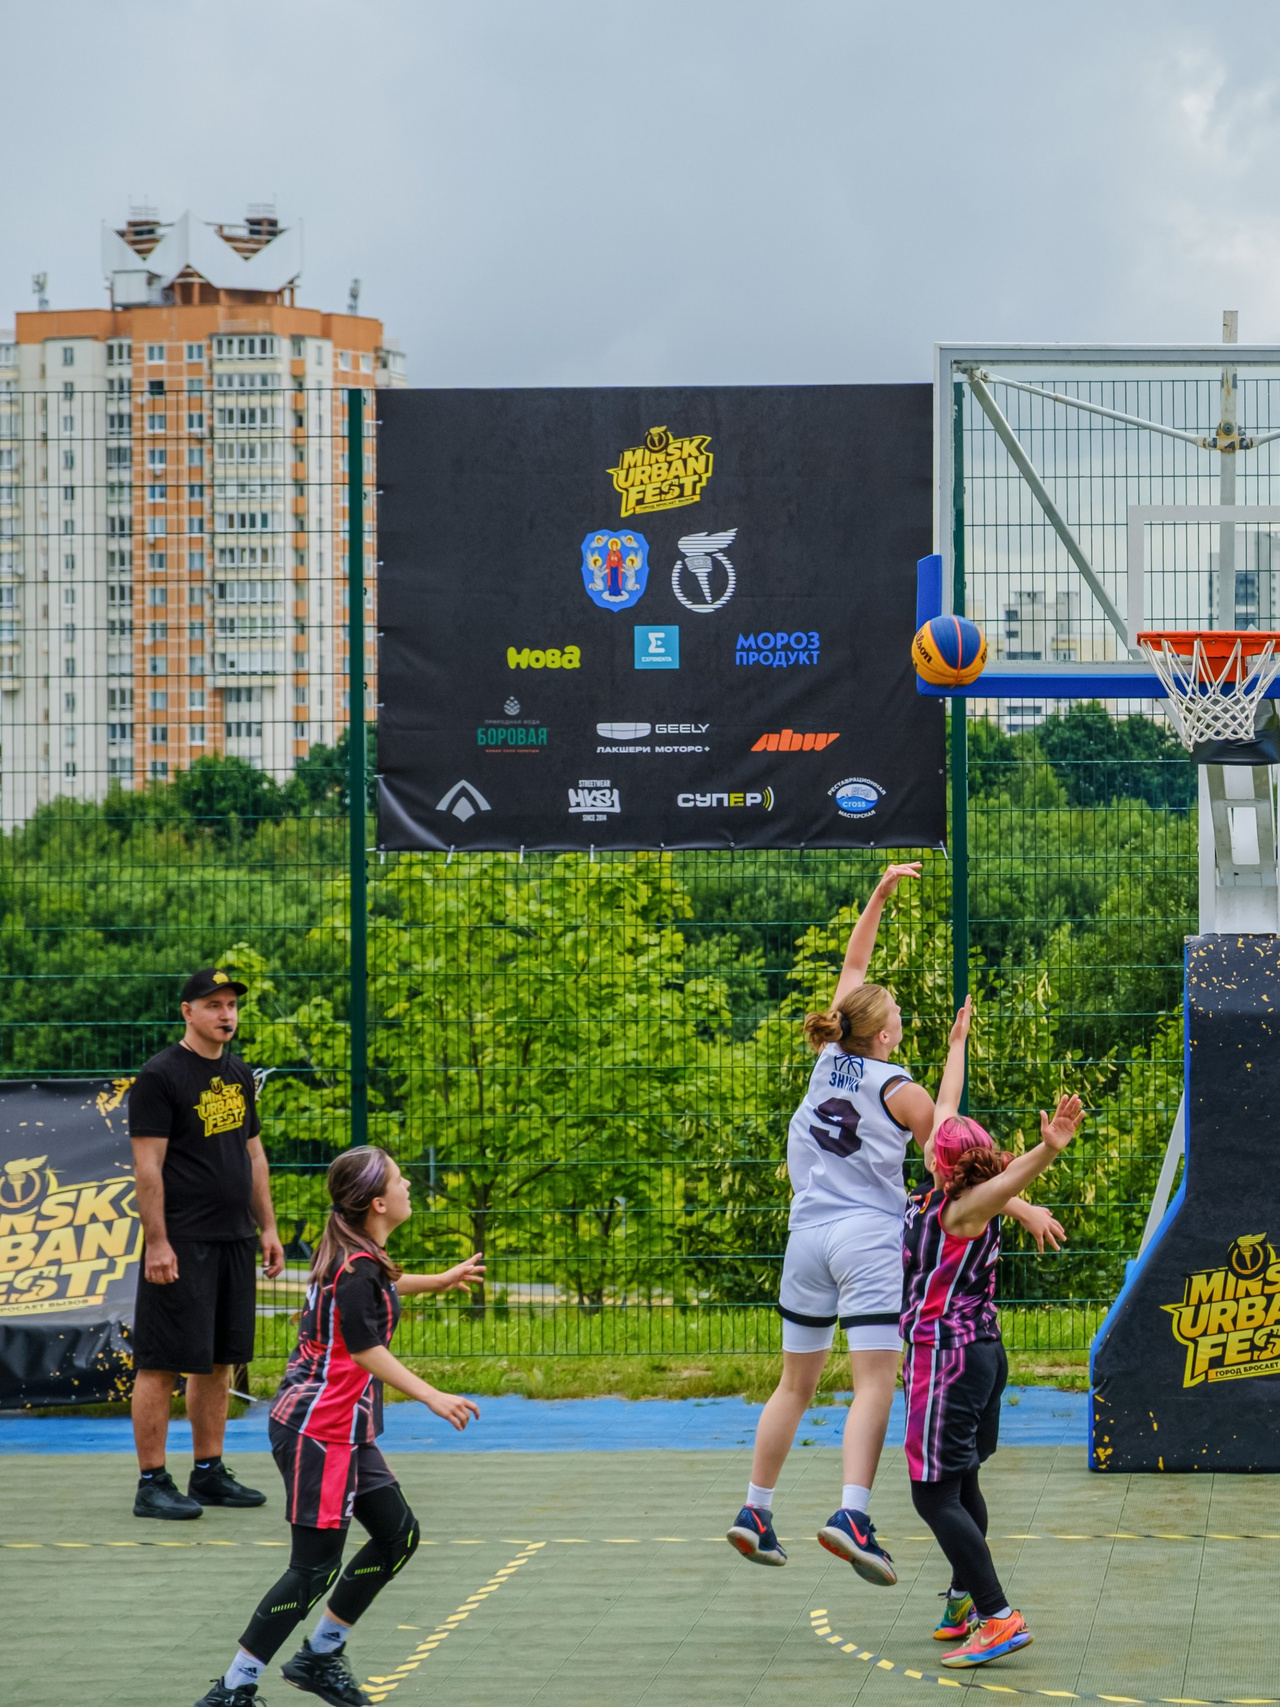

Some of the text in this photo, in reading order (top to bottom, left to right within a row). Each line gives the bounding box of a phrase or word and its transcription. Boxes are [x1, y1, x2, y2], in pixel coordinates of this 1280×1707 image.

[622, 438, 703, 469] MINSK
[616, 454, 707, 489] URBAN
[626, 474, 700, 511] FEST
[736, 631, 820, 650] МОРОЗ
[735, 651, 820, 668] ПРОДУКТ
[477, 727, 548, 746] БОРОВАЯ
[655, 723, 710, 734] GEELY
[596, 746, 651, 754] ЛАКШЕРИ
[677, 792, 762, 807] СУПЕР
[201, 1086, 238, 1106] MINSK
[200, 1096, 243, 1118] URBAN
[207, 1109, 240, 1132] FEST
[0, 1182, 129, 1237] NSK
[0, 1217, 133, 1273] BAN
[0, 1298, 90, 1313] РОСАЕТ ВЫЗОВ
[1215, 1367, 1242, 1377] ГОРОД
[1243, 1361, 1279, 1373] БРОСАЕТ
